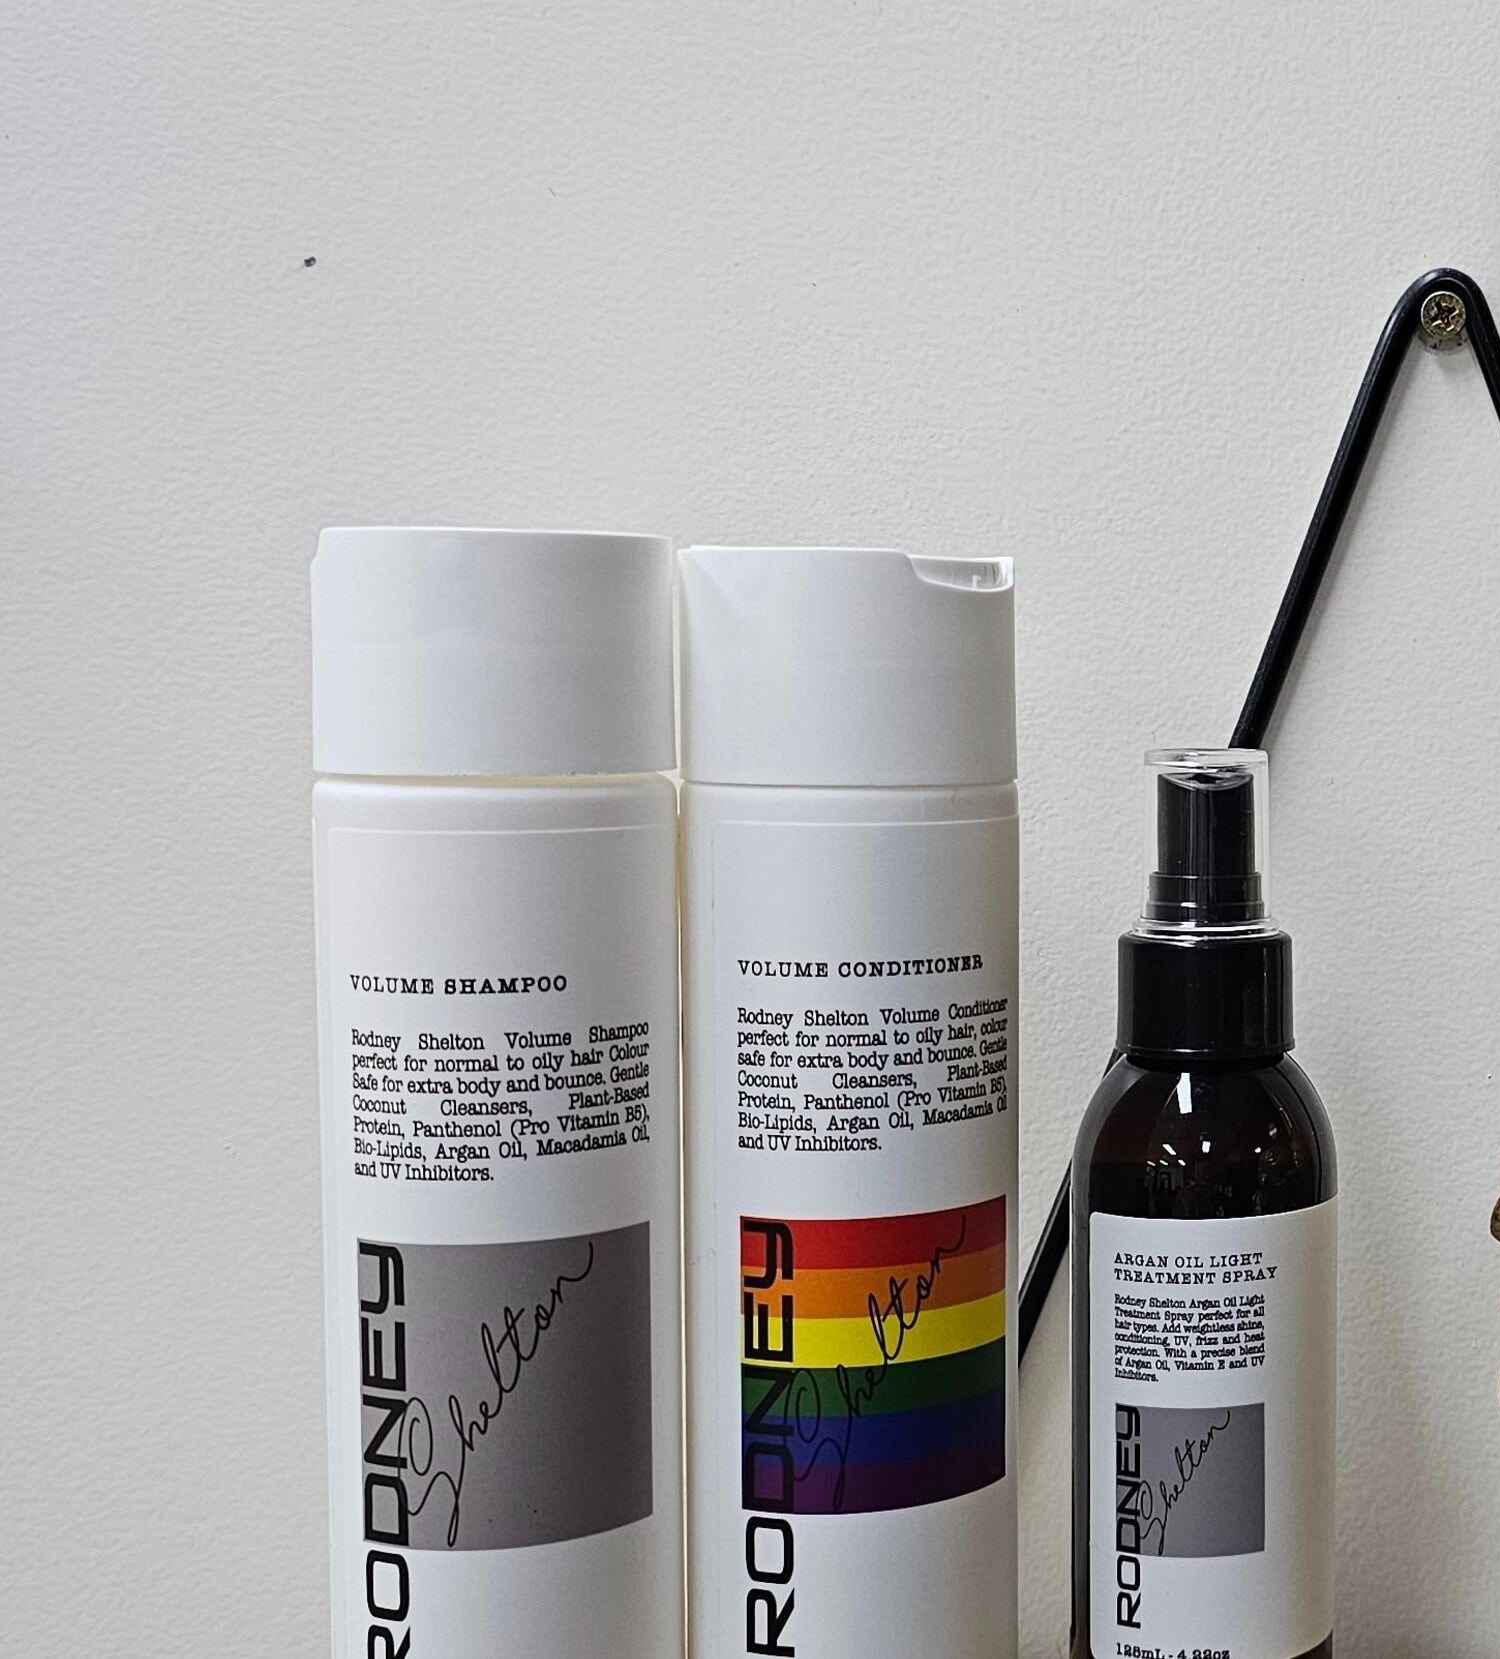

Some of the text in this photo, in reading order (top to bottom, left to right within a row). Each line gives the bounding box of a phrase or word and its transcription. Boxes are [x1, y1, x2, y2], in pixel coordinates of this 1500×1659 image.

[738, 955, 983, 978] VOLUME CONDITIONER
[350, 974, 568, 994] VOLUME SHAMPOO
[737, 998, 1008, 1029] Rodney Shelton Volume Conditioner
[351, 1021, 649, 1050] Rodney Shelton Volume Shampoo
[737, 1019, 1008, 1048] perfect for normal to oily hair, colour
[352, 1042, 649, 1072] perfect for normal to oily hair Colour
[737, 1036, 1007, 1071] safe for extra body and bounce. Gentle
[352, 1062, 649, 1097] Safe for extra body and bounce. Gentle
[738, 1058, 1007, 1089] Coconut Cleansers, Plant-Based
[352, 1082, 649, 1117] Coconut Cleansers, Plant-Based
[738, 1092, 796, 1111] Protein,
[803, 1091, 889, 1110] Panthenol
[897, 1090, 931, 1110] (Pro
[938, 1082, 987, 1103] Vitamin
[353, 1104, 650, 1141] Protein, Panthenol (Pro Vitamin B5),
[738, 1113, 817, 1134] Bio-Lipids,
[827, 1115, 879, 1133] Argan
[888, 1111, 914, 1131] Oil,
[922, 1104, 993, 1126] Macadamia
[353, 1138, 427, 1161] Bio-Lipids,
[434, 1142, 490, 1162] Argan
[498, 1141, 527, 1161] Oil,
[536, 1133, 627, 1157] Macadamia
[738, 1135, 882, 1151] and UV Inhibitors.
[354, 1161, 494, 1182] and UV Inhibitors.
[1114, 1252, 1262, 1268] ARGAN OIL LIGHT
[1114, 1266, 1278, 1284] TREATMENT SPRAY
[1114, 1294, 1265, 1310] Rodney Shelton Argan Oil Light
[1114, 1306, 1265, 1322] Treatment Spray perfect for all
[1114, 1319, 1265, 1335] hair types. Add weightless shine,
[1174, 1336, 1192, 1347] UV,
[1196, 1335, 1219, 1346] frizz
[1223, 1335, 1240, 1344] and
[1244, 1332, 1265, 1341] heat
[785, 1213, 966, 1510] Shelton
[1114, 1355, 1265, 1372] of Argan Oil, Vitamin E and UV
[1165, 1348, 1187, 1358] With
[1201, 1349, 1235, 1360] precise
[1240, 1343, 1265, 1355] blend
[1114, 1368, 1159, 1382] Inhibitors.
[399, 1241, 594, 1547] Shelton
[742, 1219, 795, 1658] RODNEY
[1135, 1410, 1231, 1556] Shelton
[1116, 1404, 1141, 1628] RODNEY
